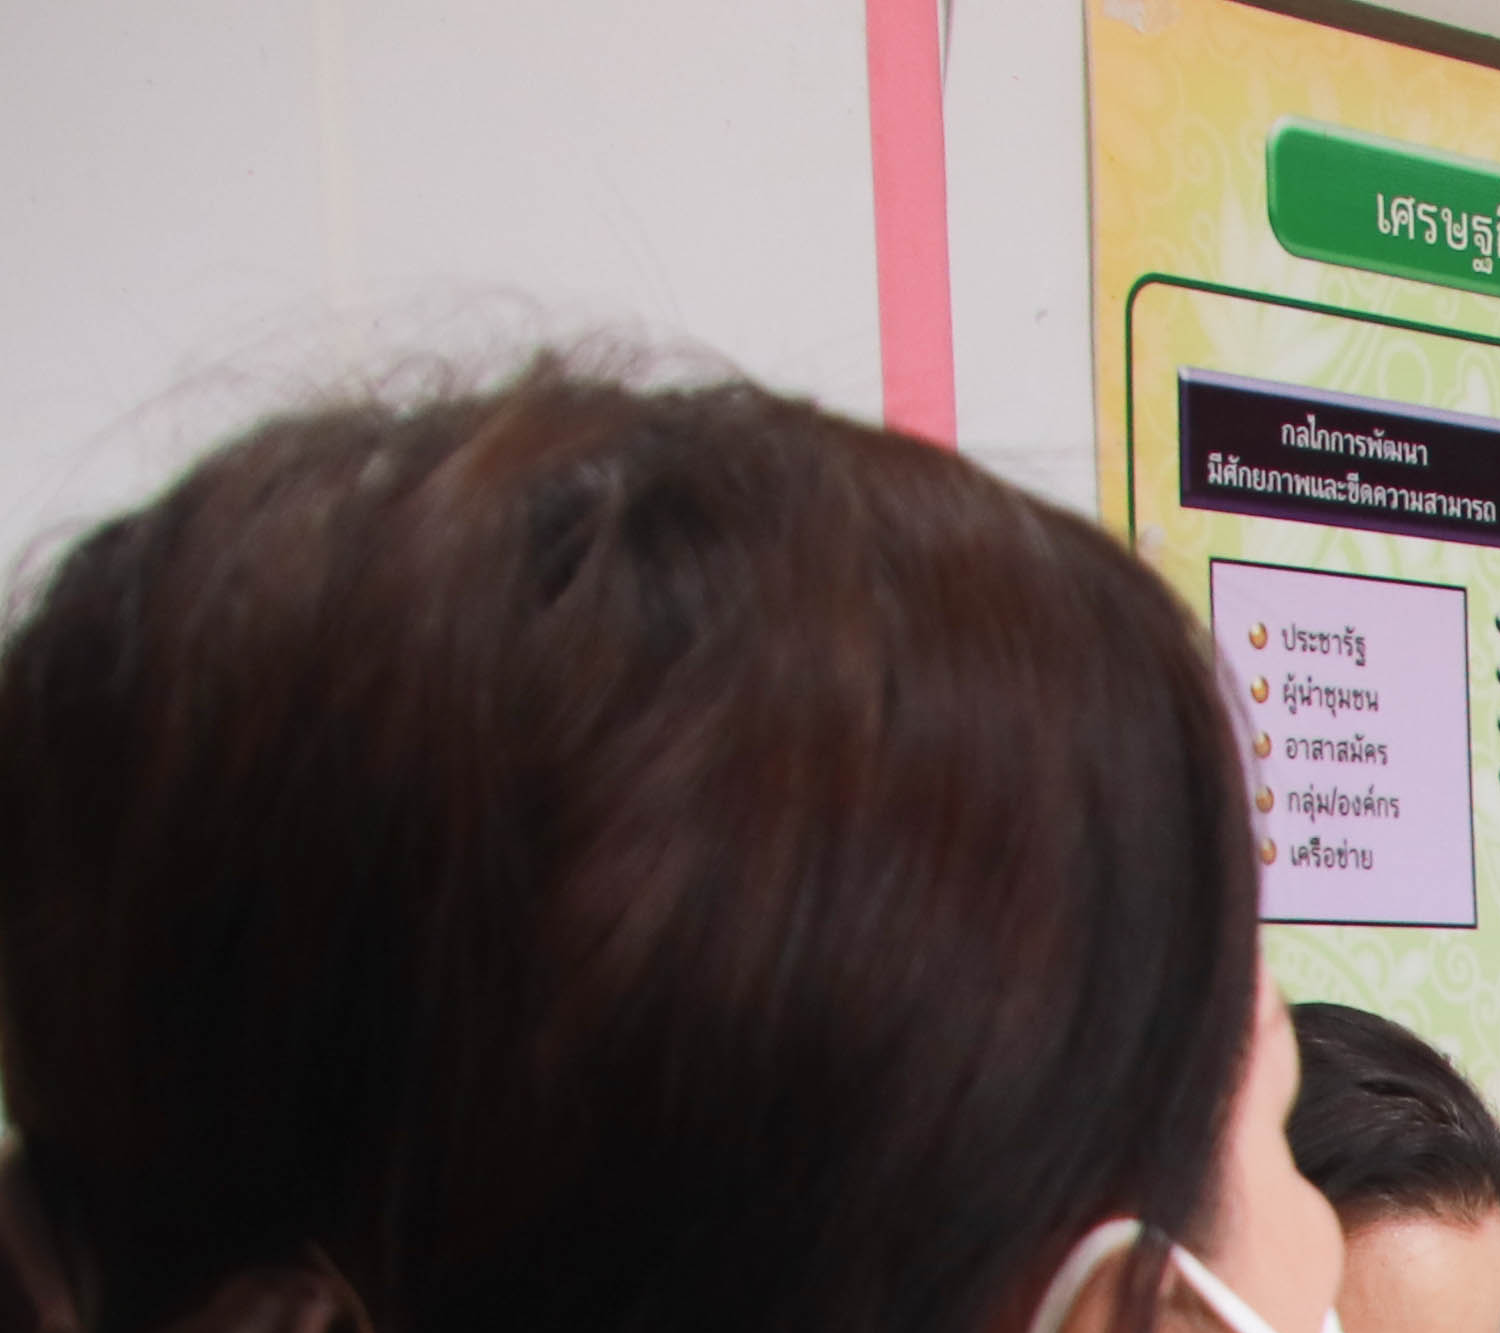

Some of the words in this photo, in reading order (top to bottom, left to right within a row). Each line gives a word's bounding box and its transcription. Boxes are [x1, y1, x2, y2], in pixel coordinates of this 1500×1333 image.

[1281, 415, 1429, 467] กลไกการพัฒนา
[1207, 452, 1497, 523] มีศักยภาพและขีดความสามารถ
[1281, 622, 1367, 667] ประชารัฐ
[1283, 672, 1379, 718] ผู้นำชุมชน
[1285, 733, 1389, 766] อาสาสมัคร
[1288, 784, 1400, 823] กลุ่ม/องค์กร
[1290, 837, 1374, 871] เครือข่าย
